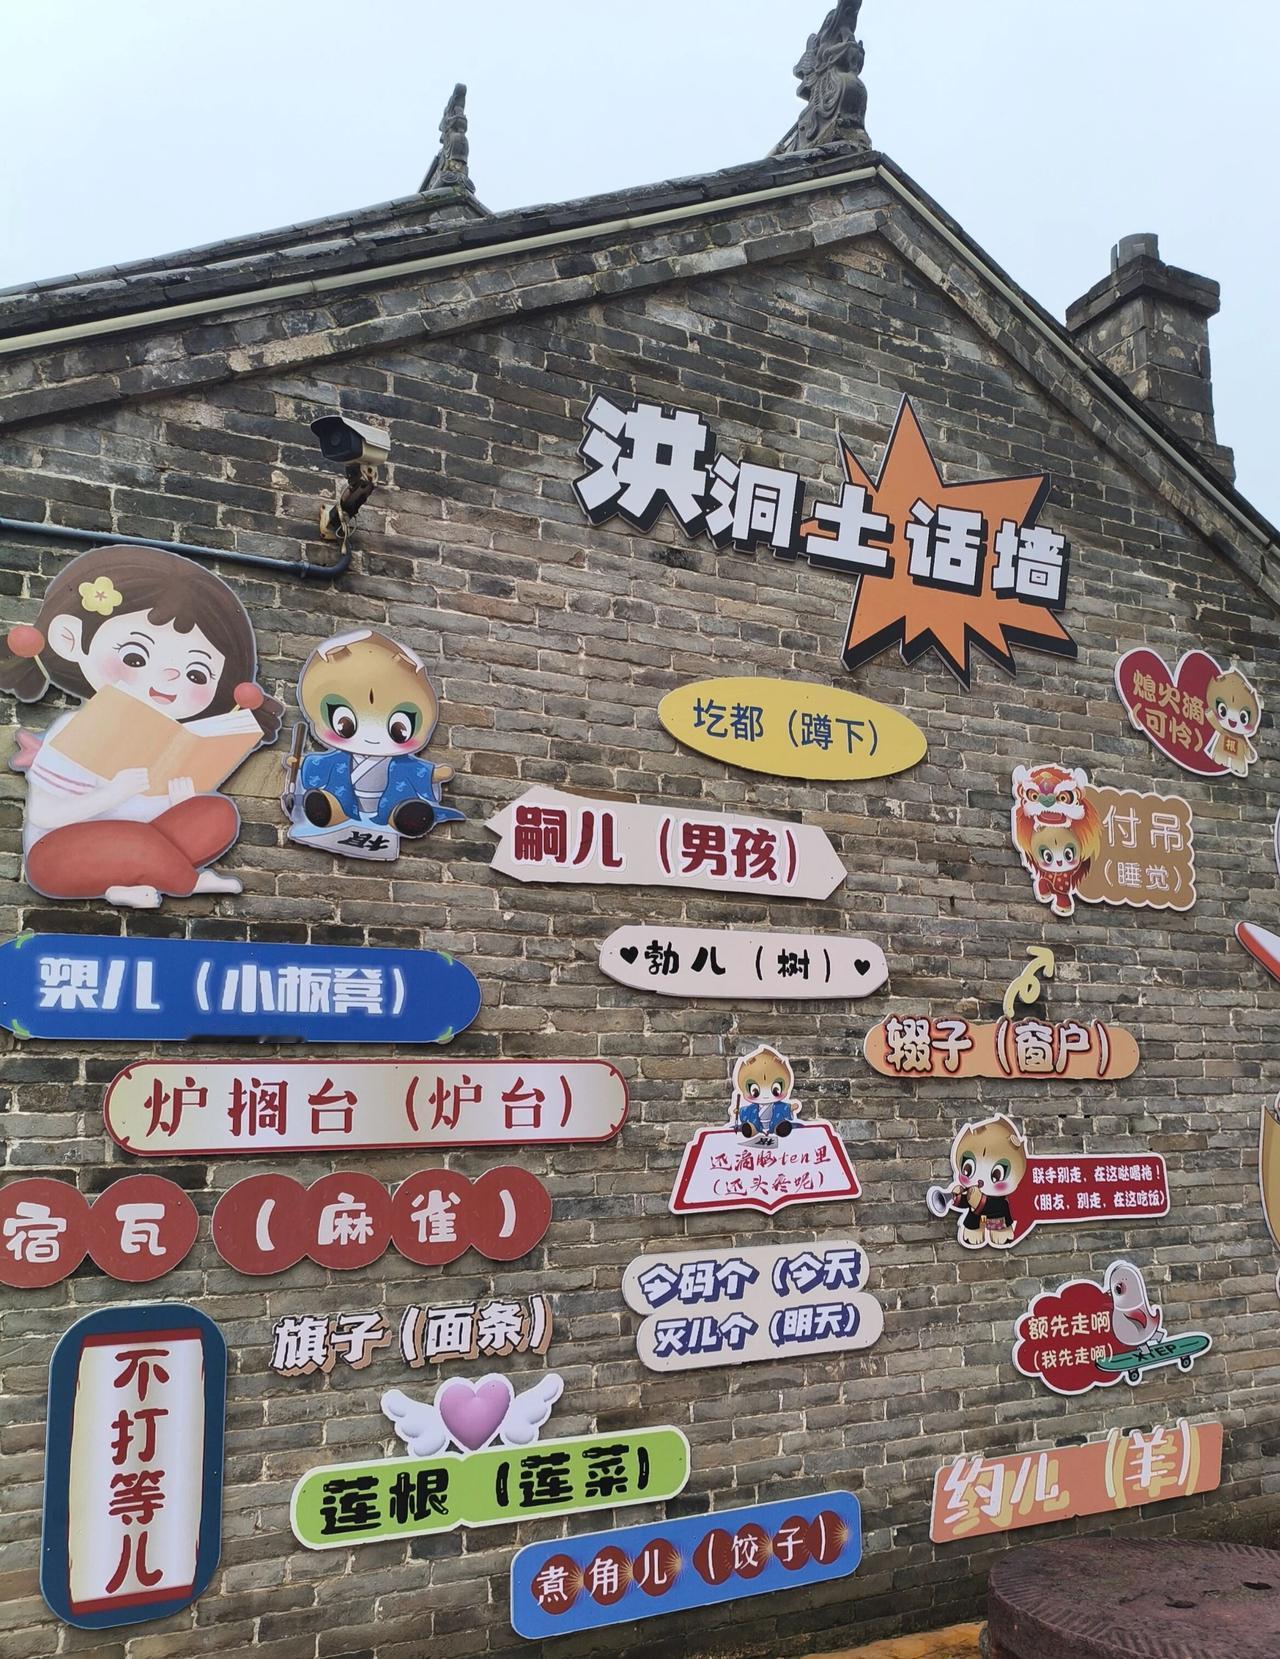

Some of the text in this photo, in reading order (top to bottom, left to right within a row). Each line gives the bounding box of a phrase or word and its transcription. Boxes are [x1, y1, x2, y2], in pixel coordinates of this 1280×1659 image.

[574, 395, 1067, 602] 洪洞土话墙
[693, 698, 878, 756] 圪都（蹲下）
[1132, 702, 1203, 752] （可怜）
[513, 805, 797, 884] 嗣儿（男孩）
[1103, 805, 1183, 853] 付吊
[1104, 859, 1182, 893] （睡觉）
[644, 941, 831, 983] 勃儿（树）
[143, 1074, 572, 1137] 炉搁台（炉台）
[2, 1190, 516, 1263] 宿瓦（麻雀）
[271, 1295, 548, 1371] 旗子（面条）
[1028, 1311, 1110, 1340] 额先走啊
[1033, 1343, 1114, 1371] （我先走啊）
[1133, 1344, 1178, 1362] XTEP
[106, 1349, 170, 1593] 不打等儿
[320, 1444, 650, 1536] 莲根（莲菜）
[944, 1418, 1194, 1526] 约儿（羊）
[537, 1515, 827, 1606] 煮角儿（饺子）
